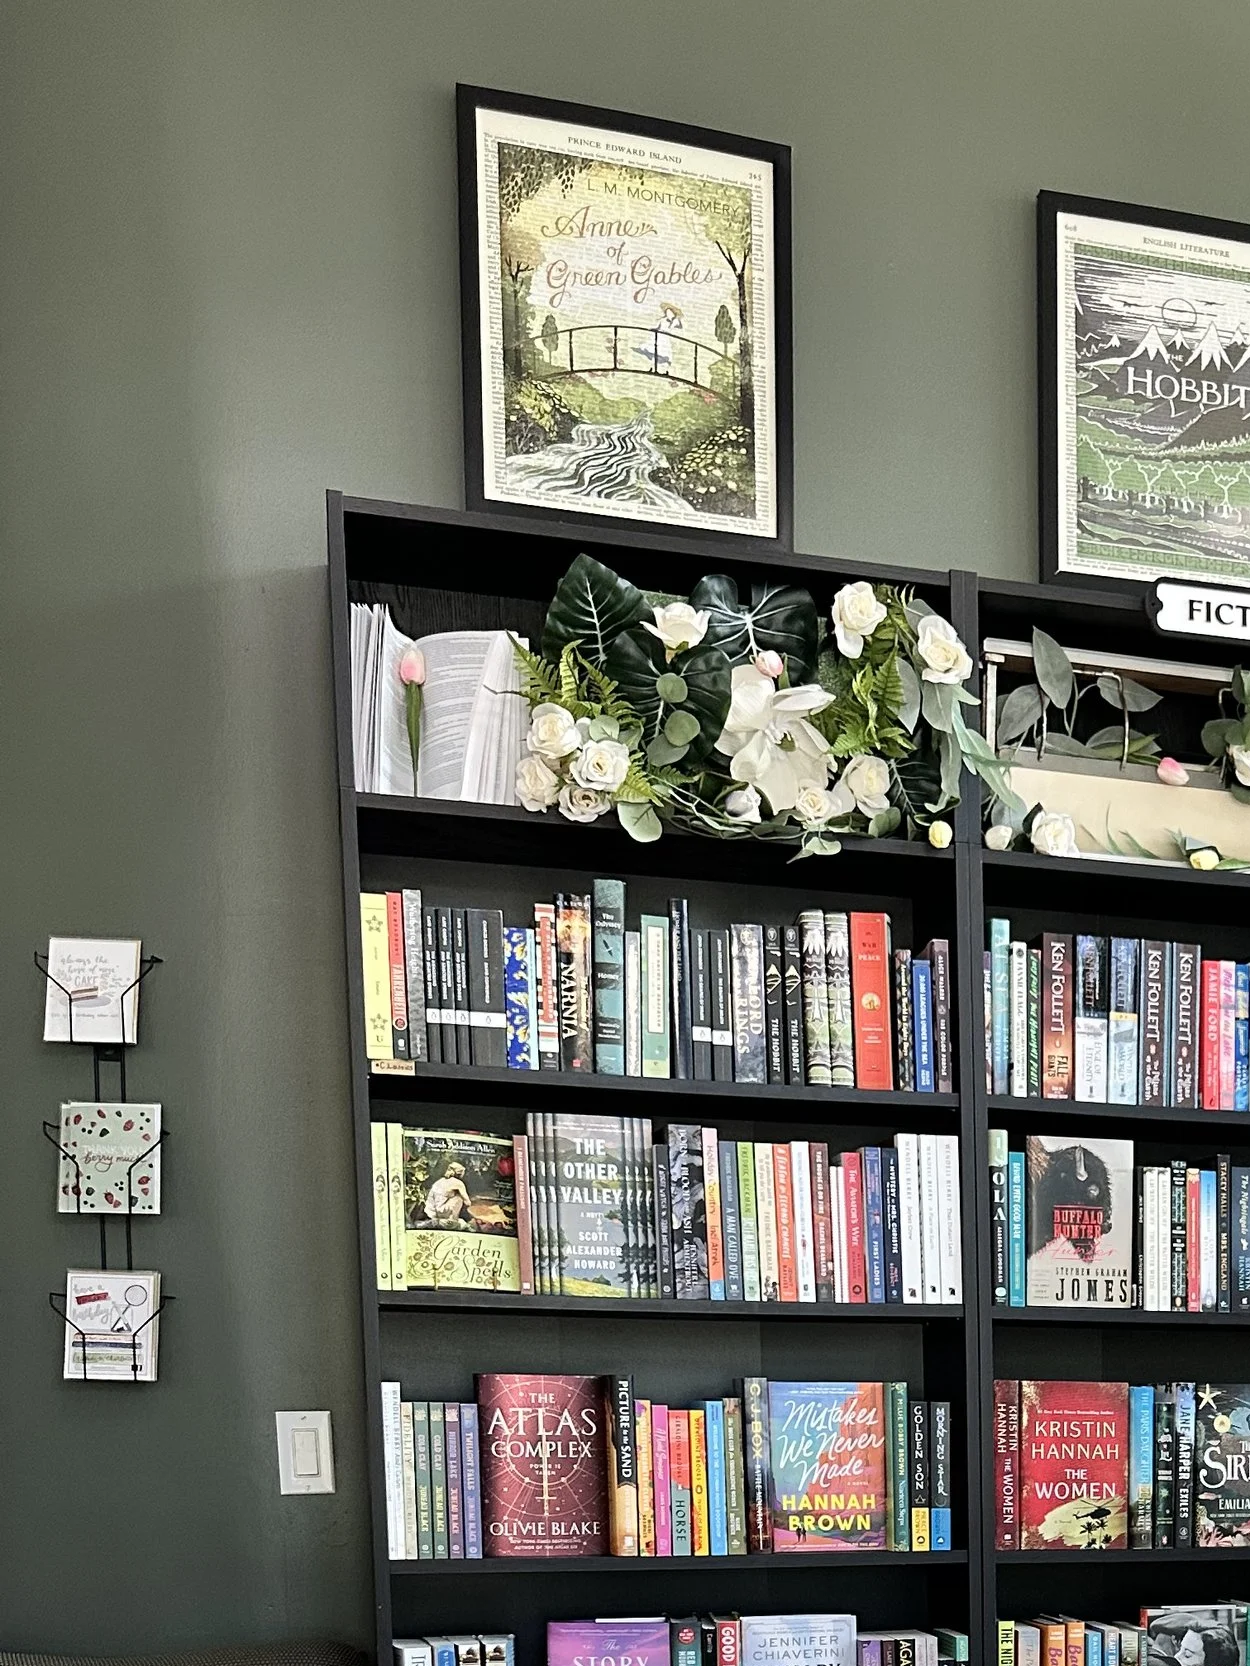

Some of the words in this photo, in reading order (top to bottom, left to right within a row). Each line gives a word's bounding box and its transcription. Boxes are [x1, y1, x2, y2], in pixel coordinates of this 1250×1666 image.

[567, 136, 601, 148] PRINCE
[604, 143, 645, 157] EDWARD
[649, 152, 683, 164] ISLAND
[587, 180, 601, 193] L.
[603, 183, 621, 197] M.
[627, 187, 740, 217] MONTGOMERY
[541, 205, 657, 238] Anne
[606, 242, 629, 265] of
[1143, 237, 1177, 249] ENGLISH
[1179, 243, 1230, 259] LITERATURE
[546, 259, 626, 308] Green
[631, 255, 723, 303] Gables
[1051, 942, 1065, 970] KEN
[560, 962, 578, 1040] NARNIA
[1050, 973, 1065, 1036] FOLLETT
[573, 1138, 606, 1156] THE
[563, 1161, 618, 1180] OTHER
[561, 1186, 622, 1205] VALLEY
[578, 1231, 608, 1242] SCOTT
[433, 1236, 502, 1270] Garden
[565, 1246, 622, 1257] ALEXANDER
[461, 1256, 511, 1285] Spells
[574, 1259, 616, 1270] HOWARD
[1055, 1267, 1091, 1276] STEPHEN
[1095, 1268, 1128, 1277] GRAHAM
[1055, 1278, 1127, 1303] JONES
[529, 1392, 555, 1404] THE
[488, 1408, 597, 1437] ATLAS
[782, 1399, 878, 1433] Mistakes
[913, 1406, 923, 1459] GOLDEN
[1034, 1421, 1116, 1438] KRISTIN
[491, 1441, 592, 1459] COMPLEX
[777, 1434, 813, 1469] We
[814, 1430, 886, 1461] Never
[1031, 1443, 1119, 1460] HANNAH
[793, 1458, 863, 1491] Made
[916, 1464, 924, 1490] SON
[1064, 1469, 1087, 1480] THE
[1034, 1482, 1116, 1500] WOMEN
[782, 1494, 876, 1511] HANNAH
[1218, 1498, 1250, 1511] EMILIA
[489, 1522, 546, 1536] OLIVIE
[551, 1521, 601, 1536] BLAKE
[675, 1500, 686, 1542] HORSE
[788, 1515, 871, 1532] BROWN
[758, 1636, 839, 1648] JENNIFER
[752, 1648, 845, 1661] CHIAVERINI
